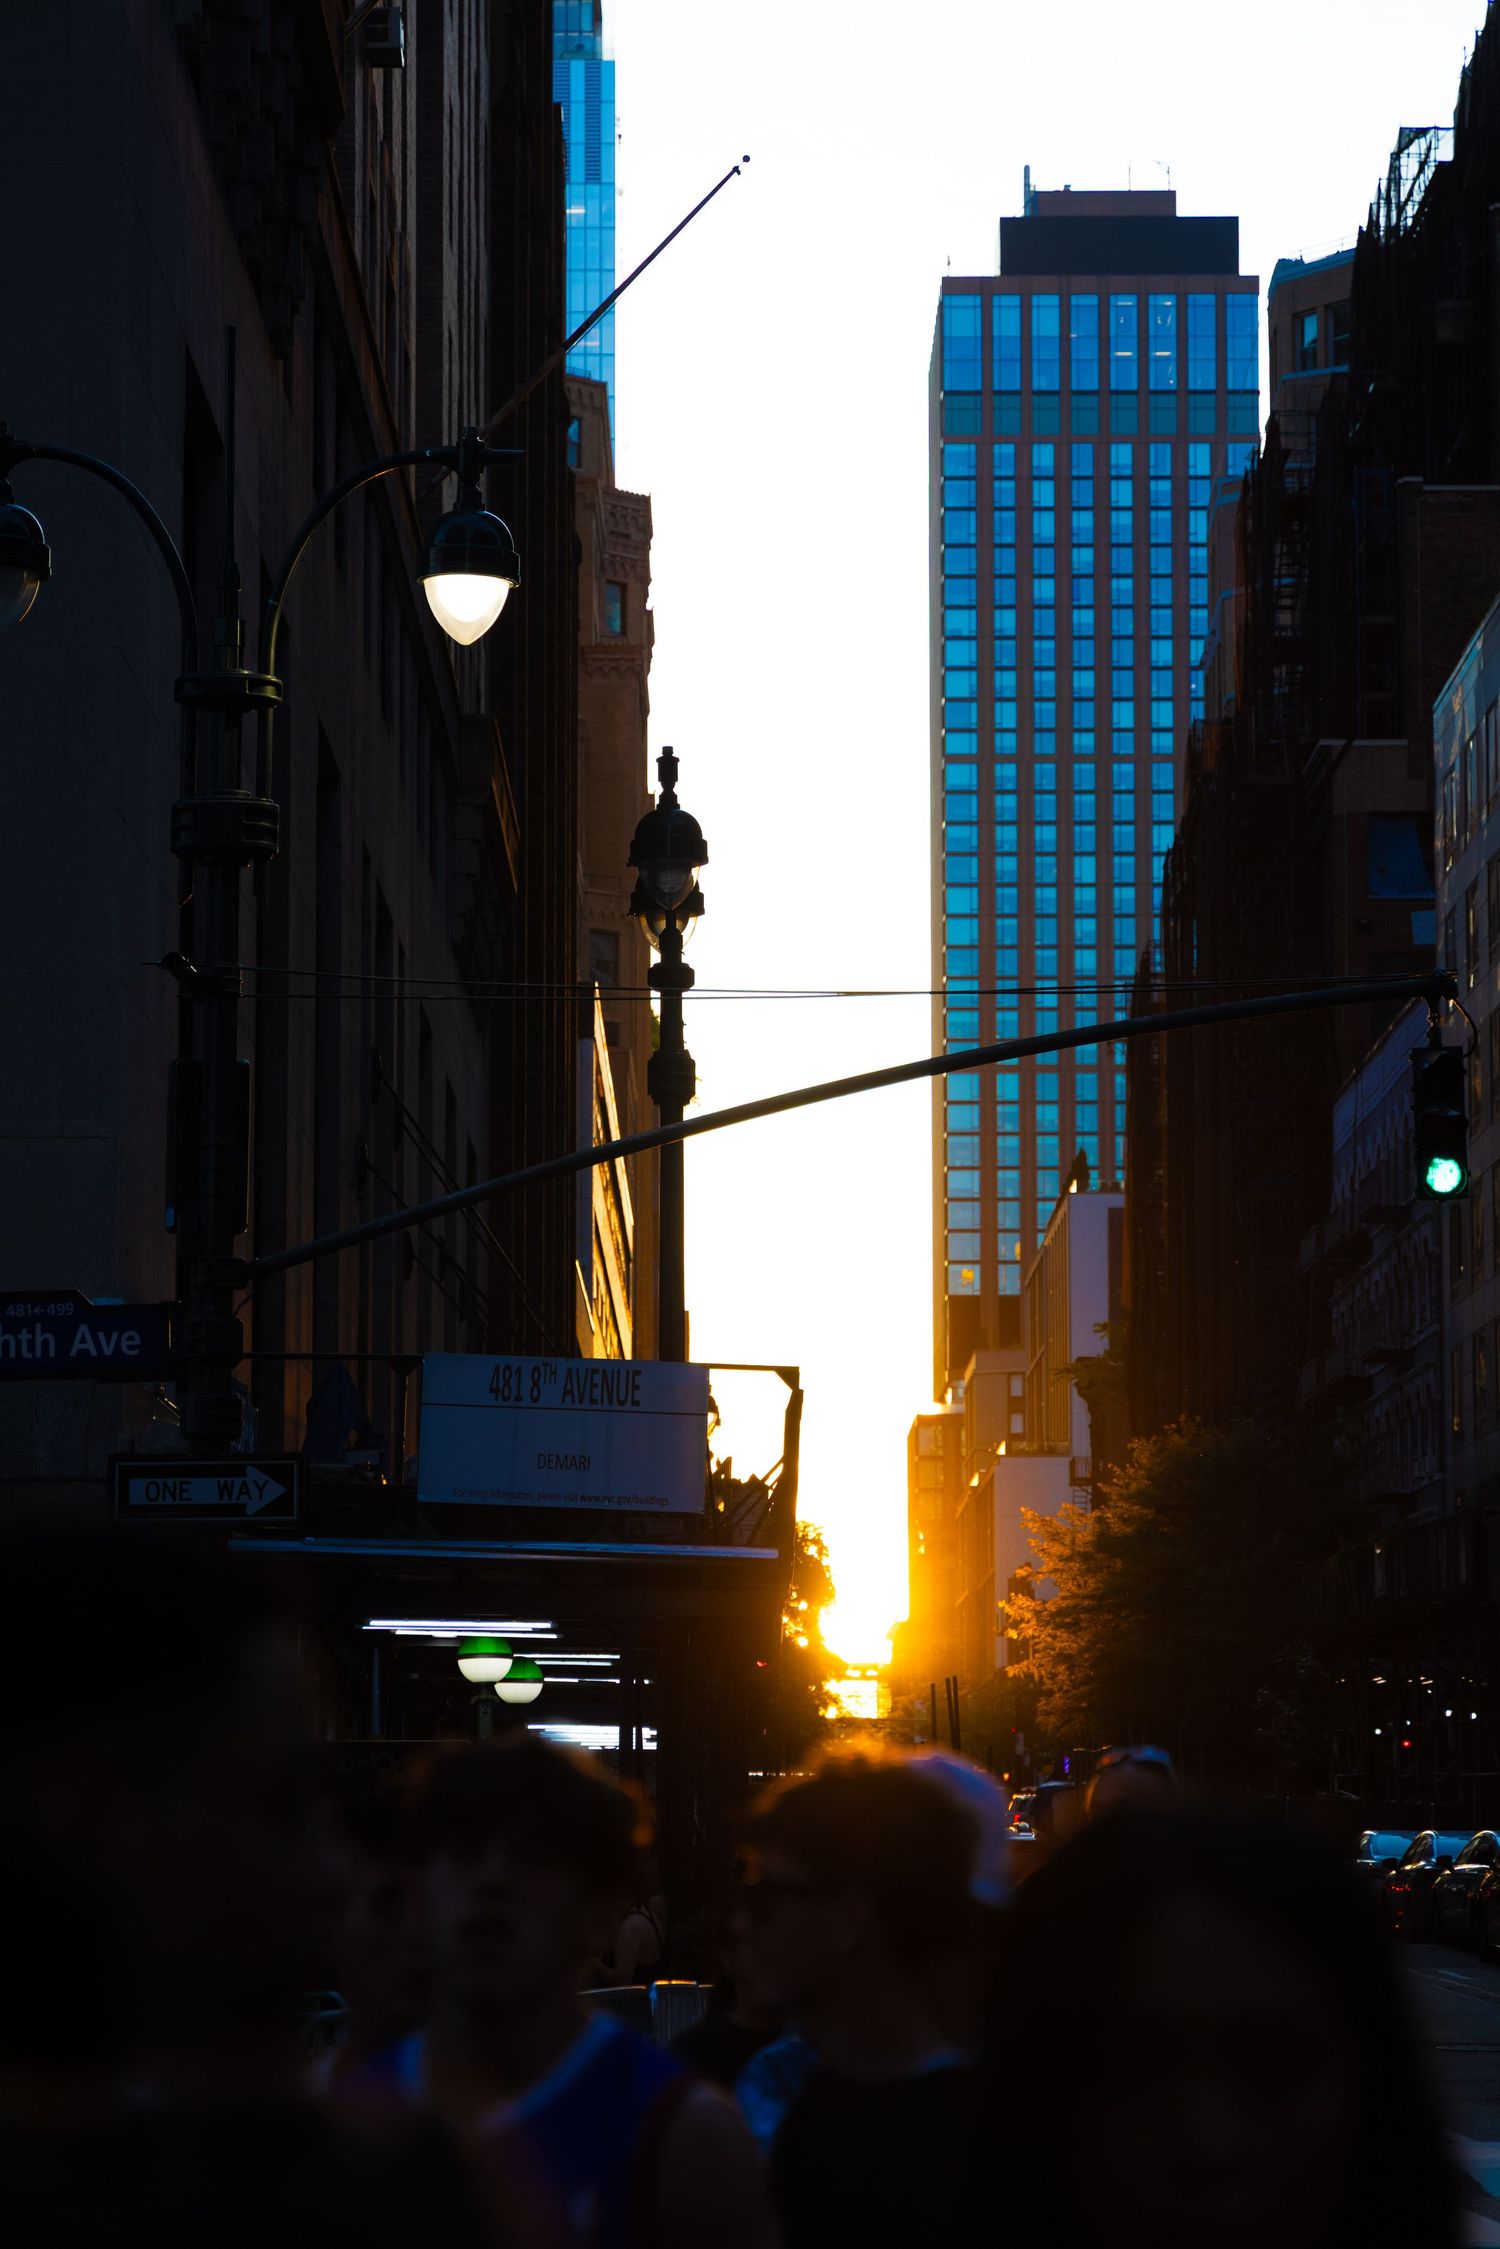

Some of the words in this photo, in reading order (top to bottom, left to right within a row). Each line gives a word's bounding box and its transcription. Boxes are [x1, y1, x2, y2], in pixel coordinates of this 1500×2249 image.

[5, 1302, 32, 1317] 481
[46, 1302, 74, 1316] 499
[68, 1323, 142, 1357] Ave
[489, 1364, 523, 1403] 481
[530, 1361, 558, 1403] 8TH
[561, 1366, 641, 1408] AVENUE
[536, 1452, 591, 1471] DEMARI
[144, 1479, 192, 1502] ONE
[216, 1479, 269, 1502] WAY
[453, 1487, 466, 1498] For
